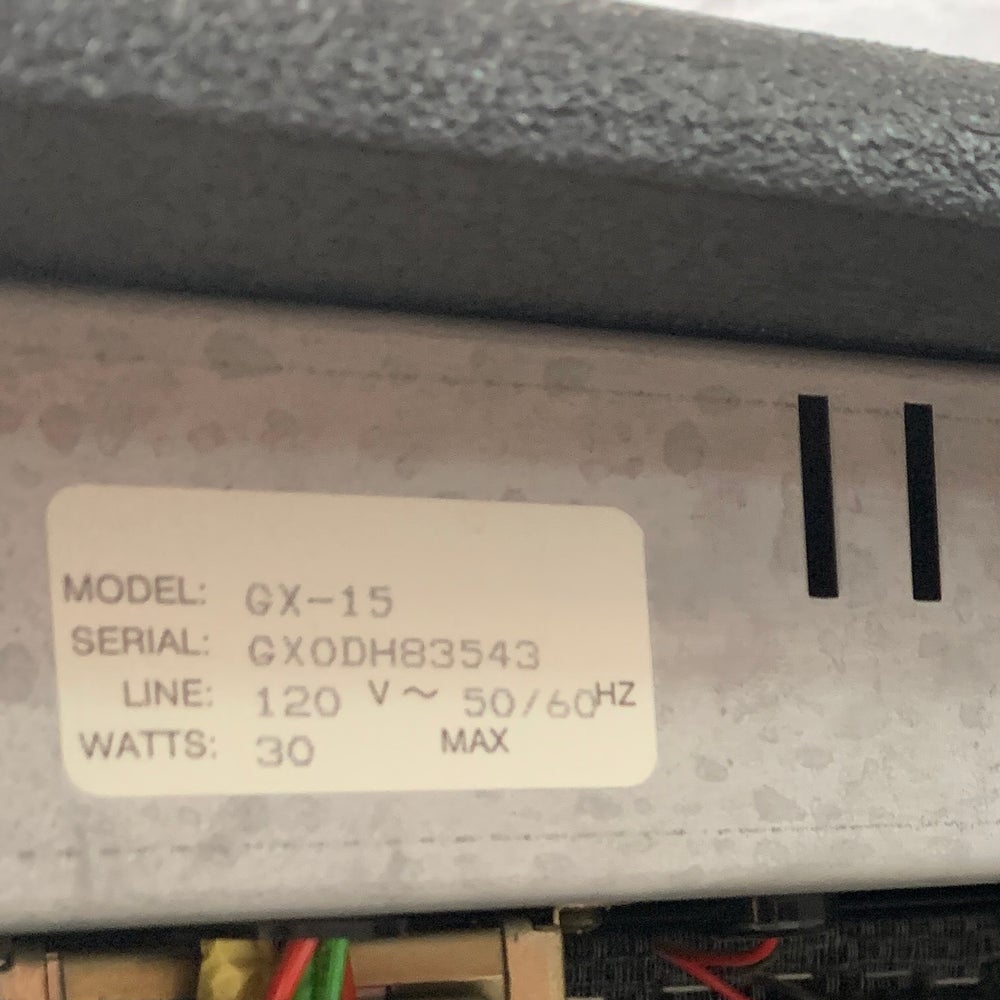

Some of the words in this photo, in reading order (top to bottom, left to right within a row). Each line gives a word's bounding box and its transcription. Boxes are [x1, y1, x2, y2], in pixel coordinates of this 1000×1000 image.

[61, 573, 207, 606] MODEL:
[245, 583, 394, 619] GX-15
[70, 626, 209, 657] SERIAL:
[123, 679, 212, 708] LINE:
[257, 686, 341, 719] 120
[79, 729, 217, 760] WATTS:
[256, 735, 314, 767] 30
[440, 728, 509, 754] MAX
